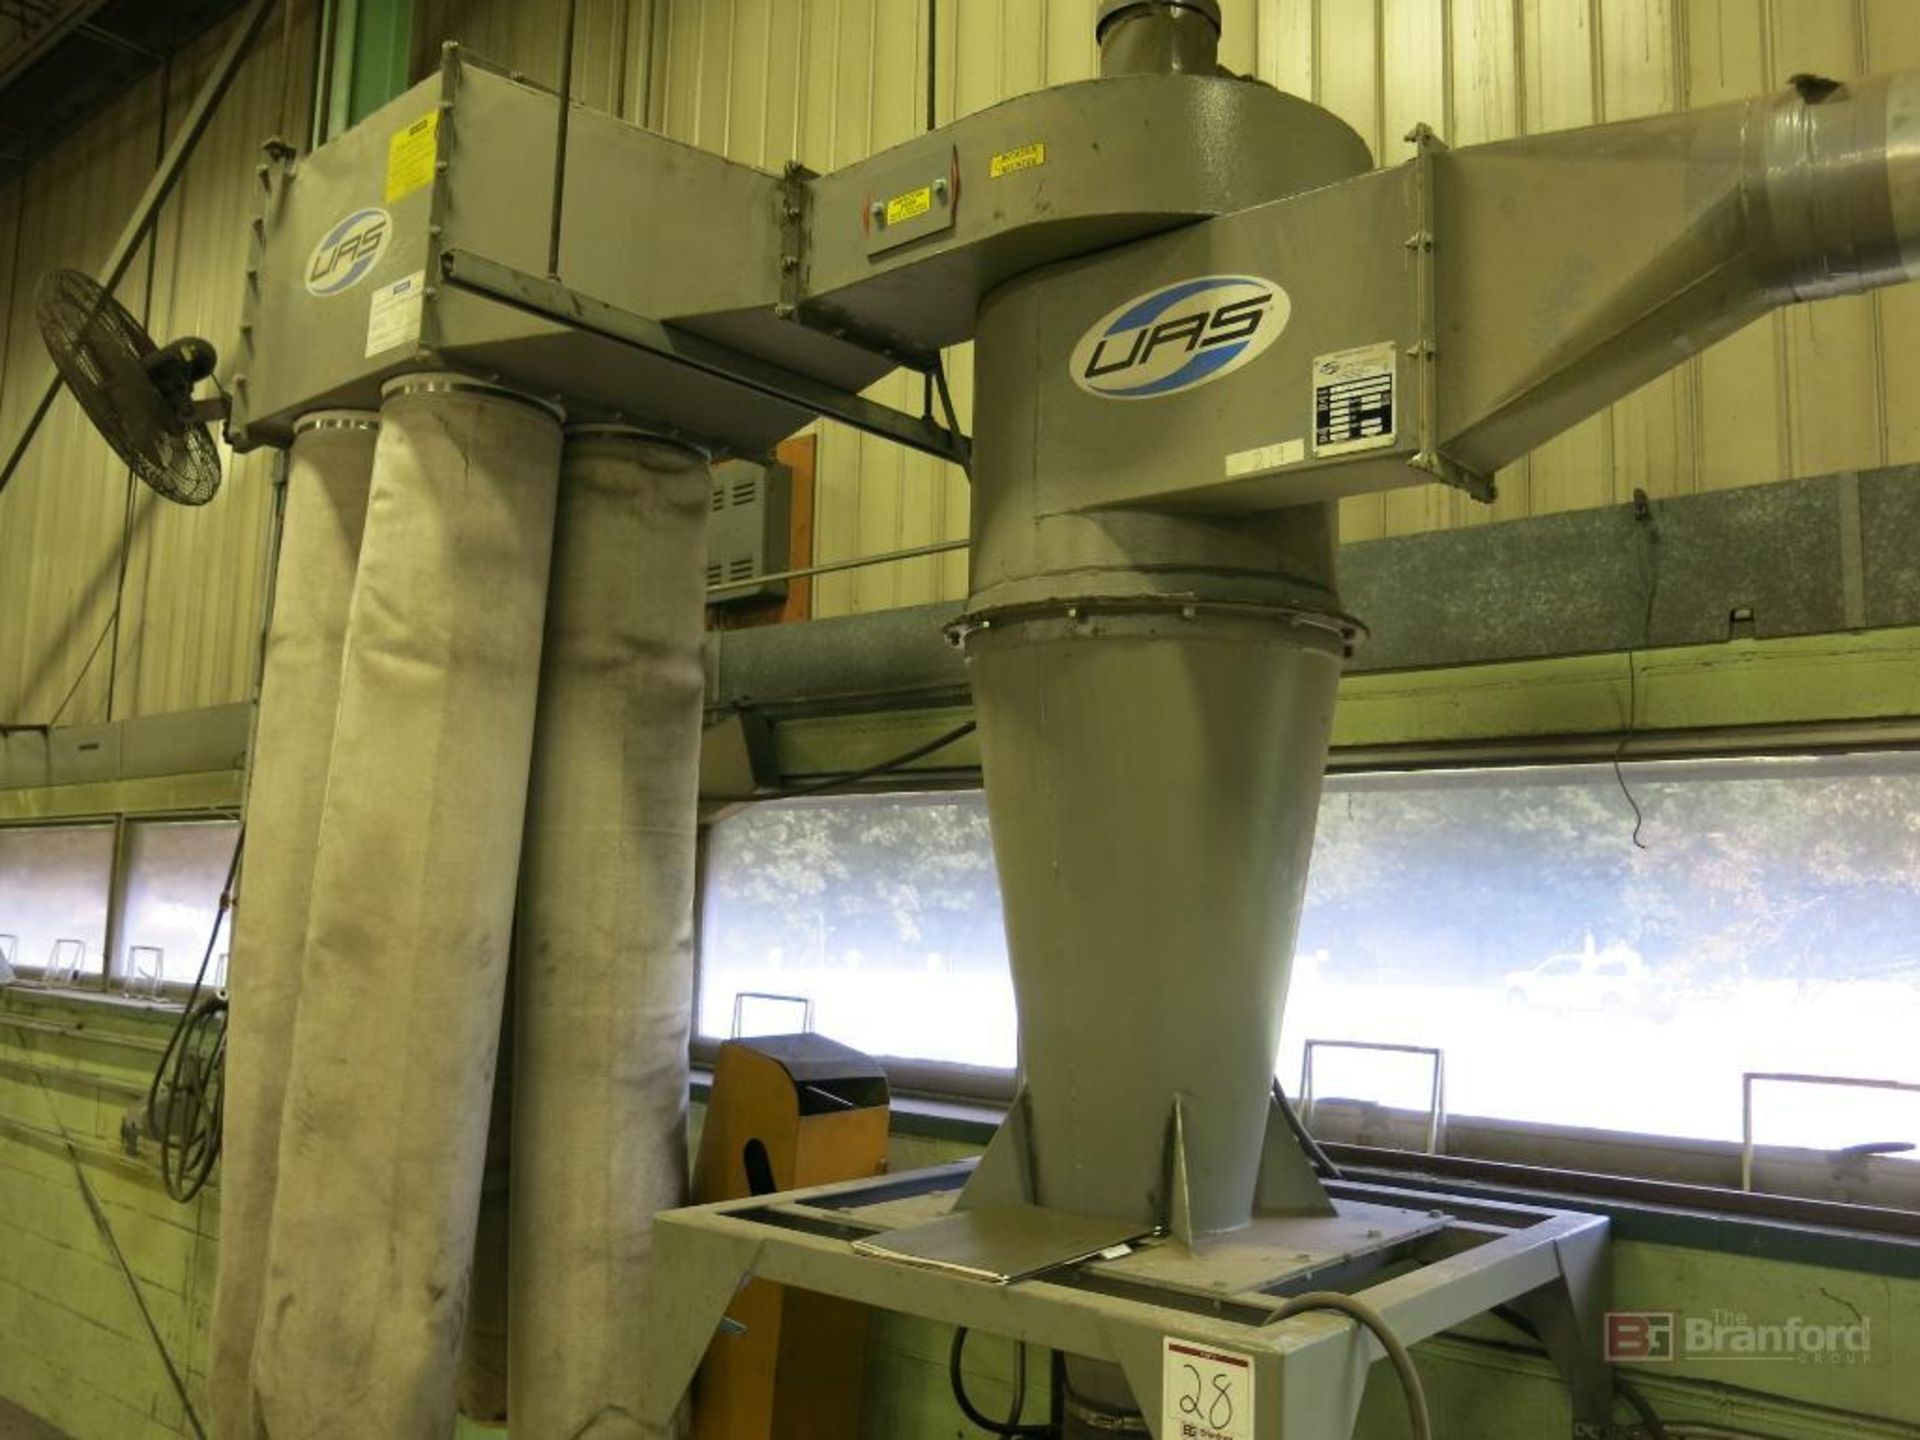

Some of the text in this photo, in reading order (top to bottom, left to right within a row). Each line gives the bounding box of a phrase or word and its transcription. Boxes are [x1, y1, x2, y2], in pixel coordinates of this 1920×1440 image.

[310, 220, 386, 282] UAS
[1084, 294, 1273, 379] UAS
[1180, 1364, 1232, 1430] 28
